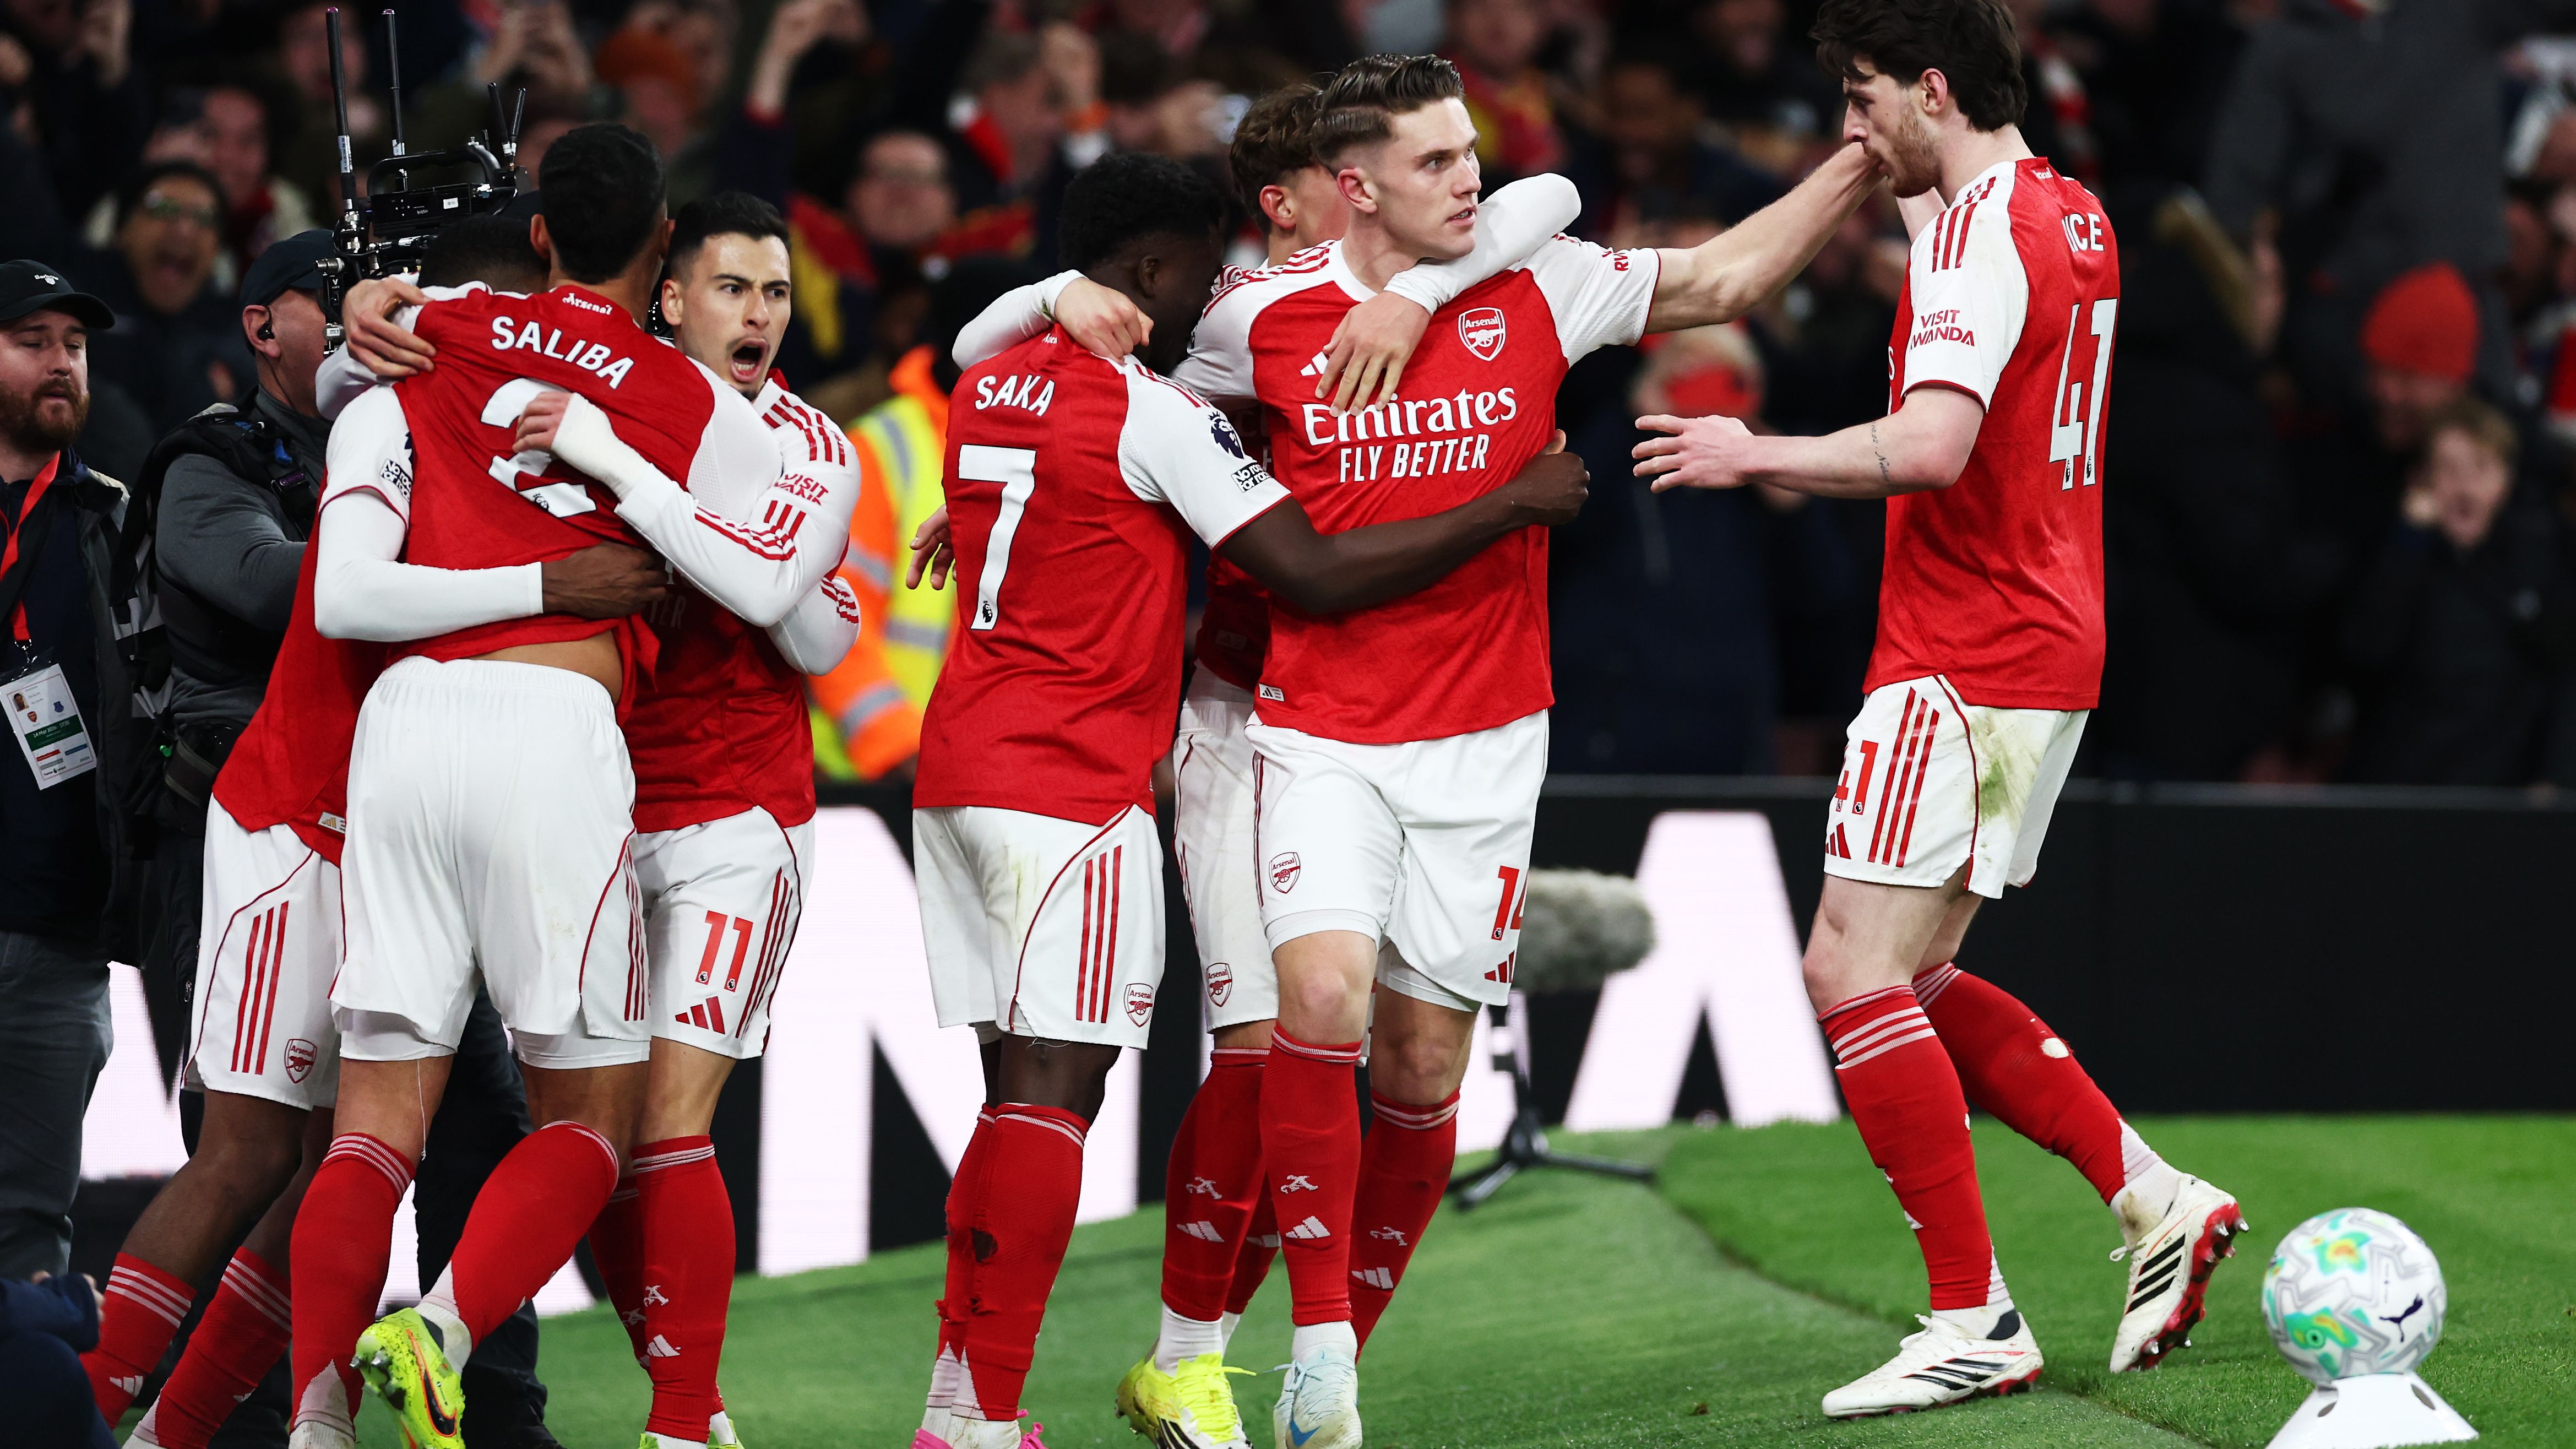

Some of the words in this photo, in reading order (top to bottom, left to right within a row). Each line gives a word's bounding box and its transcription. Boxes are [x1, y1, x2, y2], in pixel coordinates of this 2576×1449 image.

[2061, 213, 2104, 253] ICE
[562, 293, 613, 315] Arsenal
[1465, 316, 1498, 328] Arsenal
[1921, 310, 1960, 328] VISIT
[1910, 327, 1975, 349] WANDA
[491, 316, 634, 390] SALIBA
[975, 375, 1055, 417] SAKA
[2049, 298, 2117, 491] 41
[1302, 387, 1516, 446] Emirates
[1340, 446, 1383, 483] FLY
[1391, 434, 1489, 478] BETTER
[384, 459, 401, 476] No
[399, 471, 412, 492] roo
[784, 474, 829, 498] VISIT
[1231, 469, 1251, 482] No
[958, 444, 1036, 629] 7
[1273, 857, 1295, 871] Arsenal
[695, 910, 753, 992] 11
[1207, 969, 1227, 979] Arsenal
[1129, 990, 1151, 999] Arsenal
[290, 1045, 313, 1057] Arsenal
